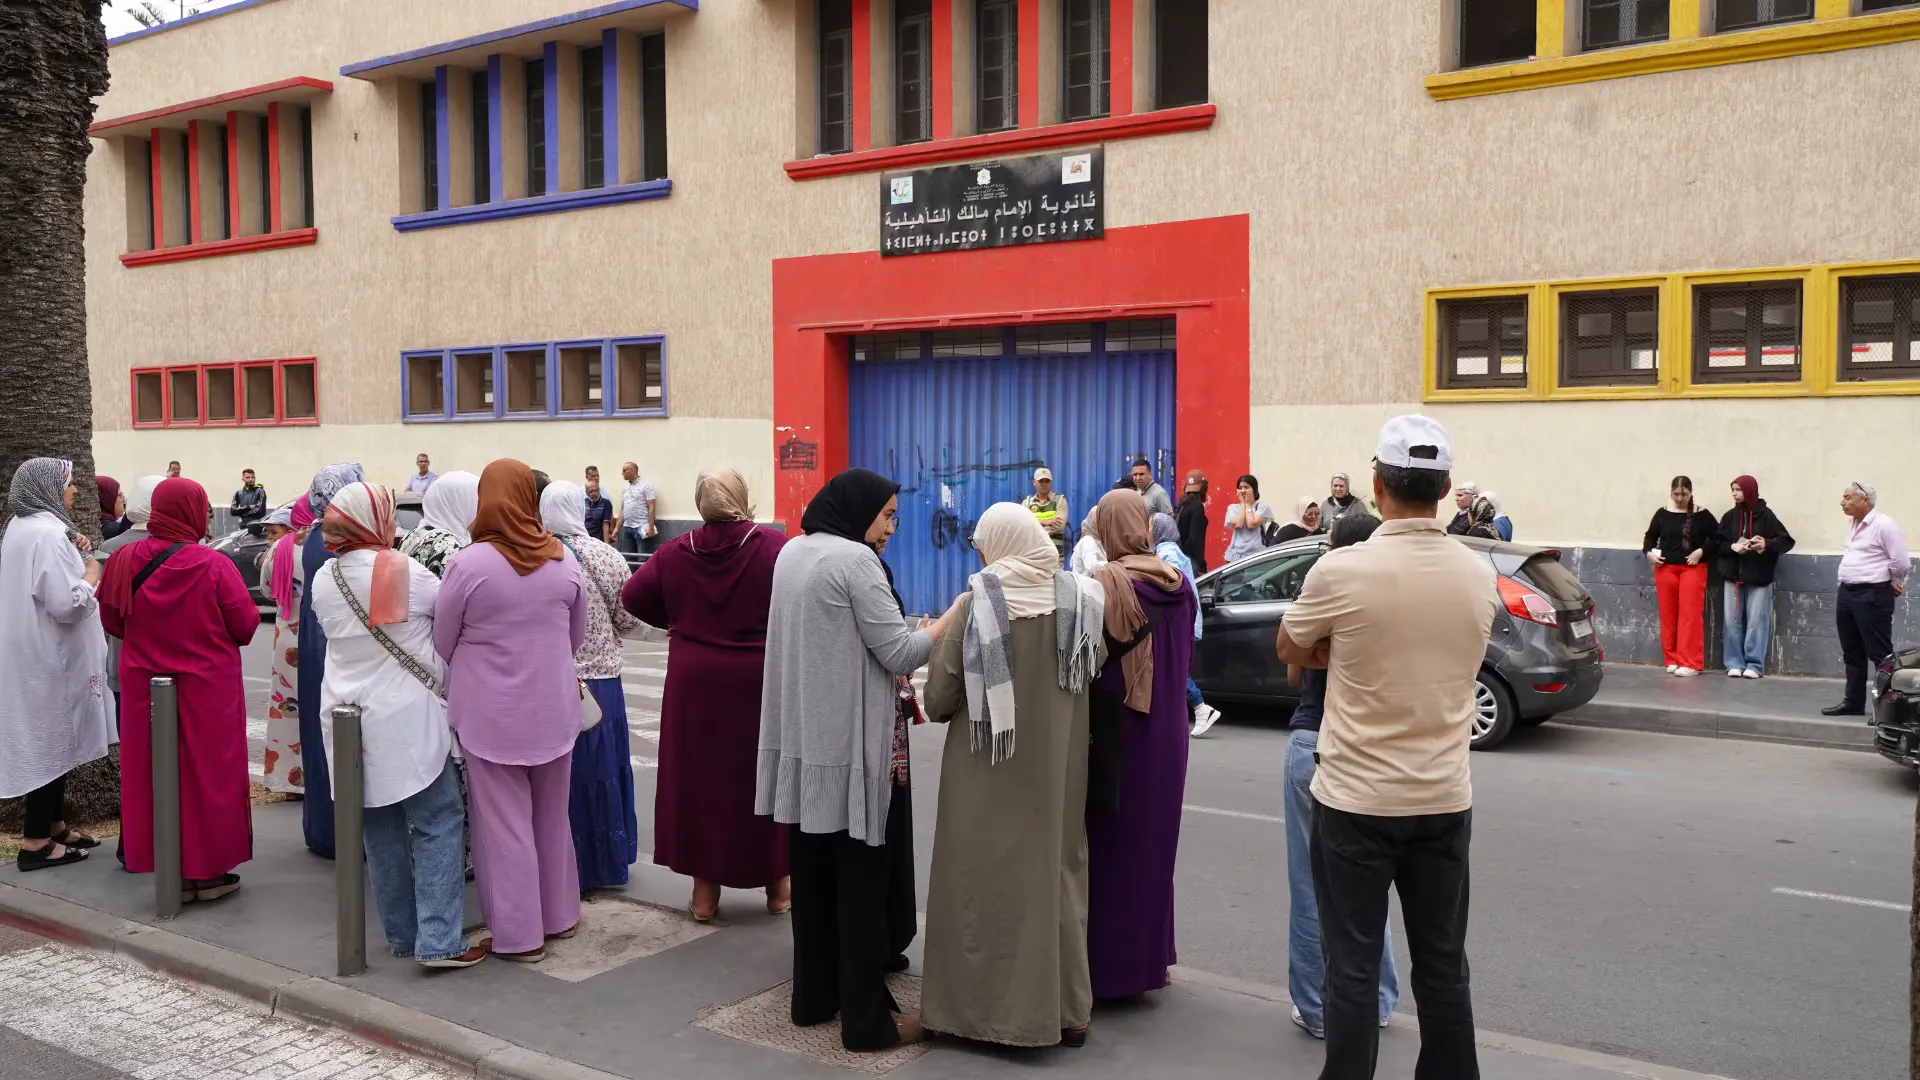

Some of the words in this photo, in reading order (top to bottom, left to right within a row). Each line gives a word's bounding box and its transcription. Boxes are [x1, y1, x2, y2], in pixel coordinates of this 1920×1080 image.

[957, 204, 989, 220] مالك
[994, 199, 1032, 224] الإمام
[1041, 191, 1096, 215] ثانوية
[885, 207, 950, 230] التأهيلية
